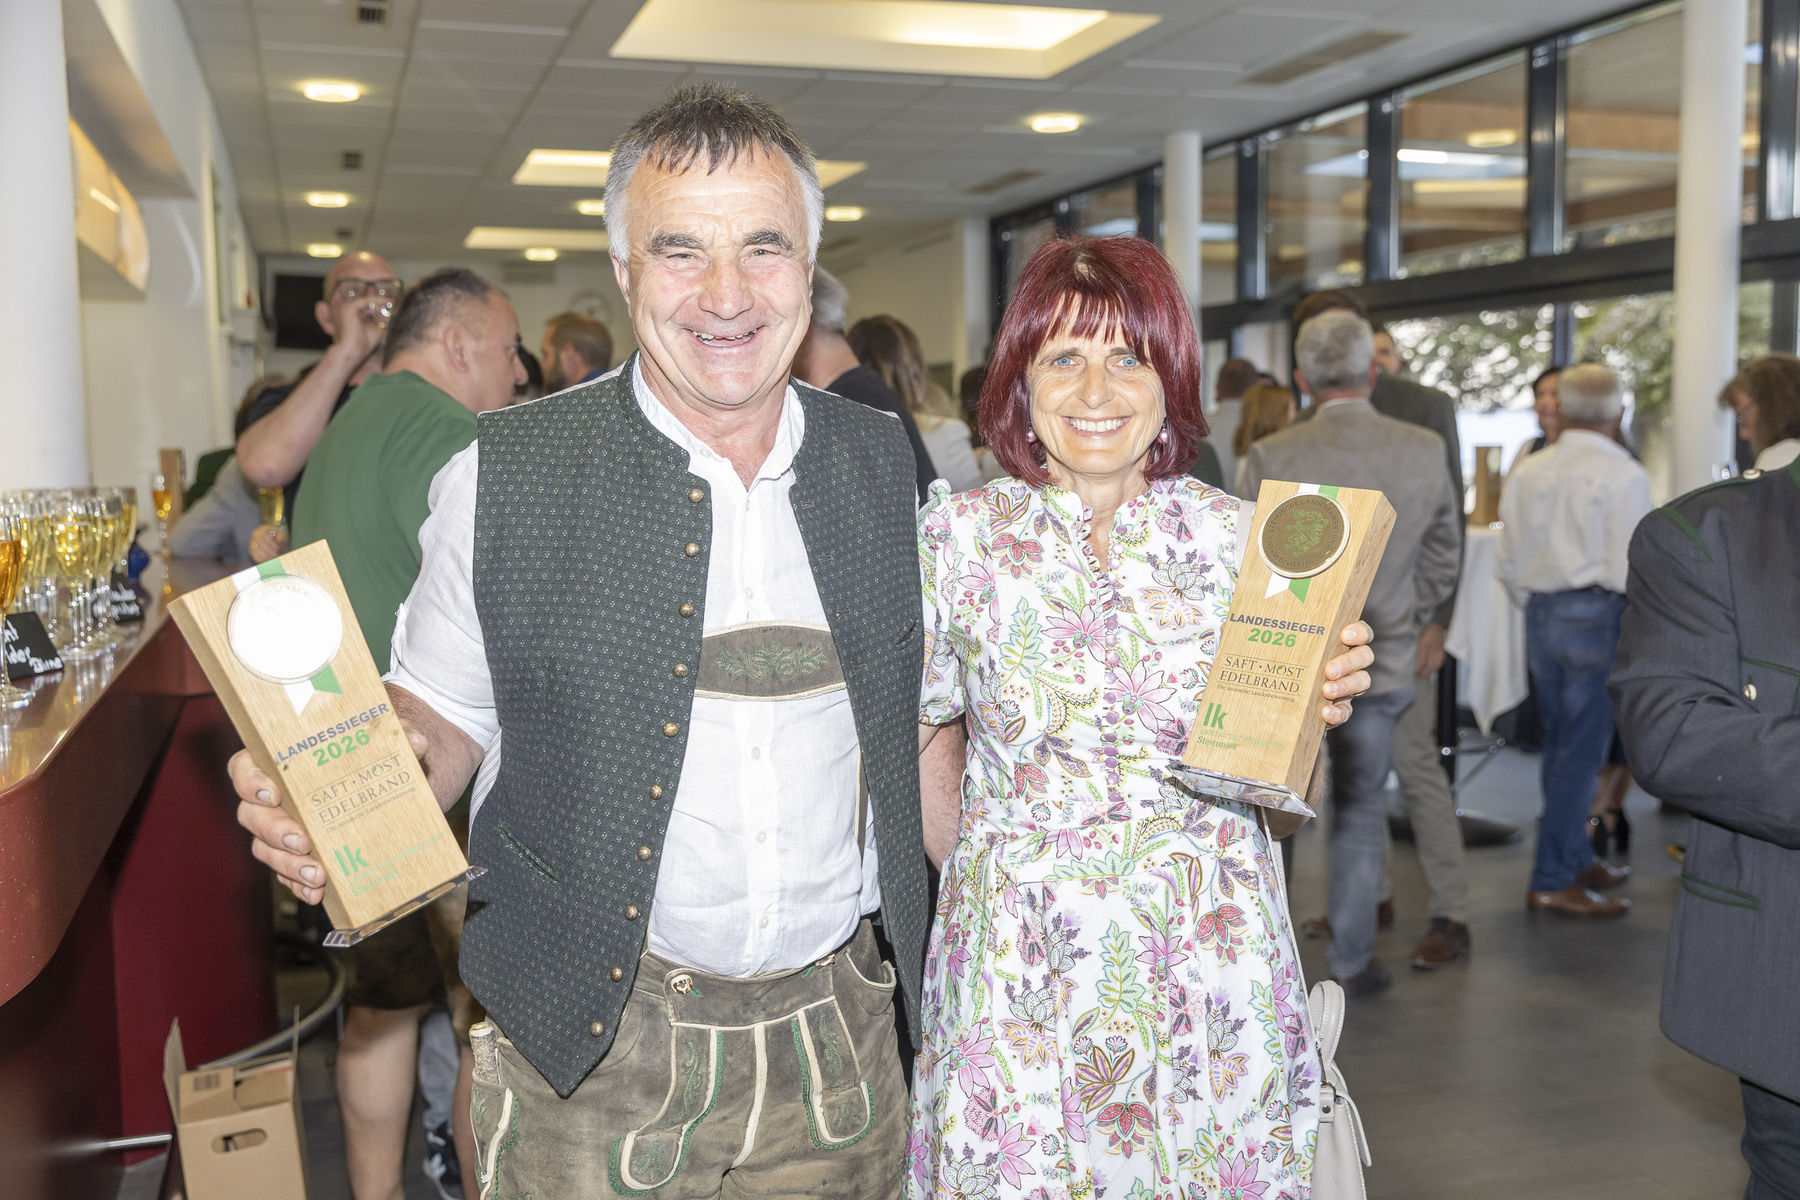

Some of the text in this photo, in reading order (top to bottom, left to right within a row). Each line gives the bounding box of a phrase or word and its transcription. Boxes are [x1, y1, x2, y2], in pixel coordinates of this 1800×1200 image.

[1230, 613, 1325, 635] LANDESSIEGER
[1248, 628, 1297, 648] 2026
[1225, 656, 1304, 678] SAFT MOST
[1220, 670, 1299, 693] EDELBRAND
[1203, 702, 1228, 730] lk
[277, 703, 389, 762] LANDESSIEGER
[1197, 736, 1238, 751] Steiermark
[313, 729, 370, 767] 2026
[312, 754, 401, 807] SAFT MOST
[319, 771, 410, 823] EDELBRAND
[333, 844, 369, 877] lk
